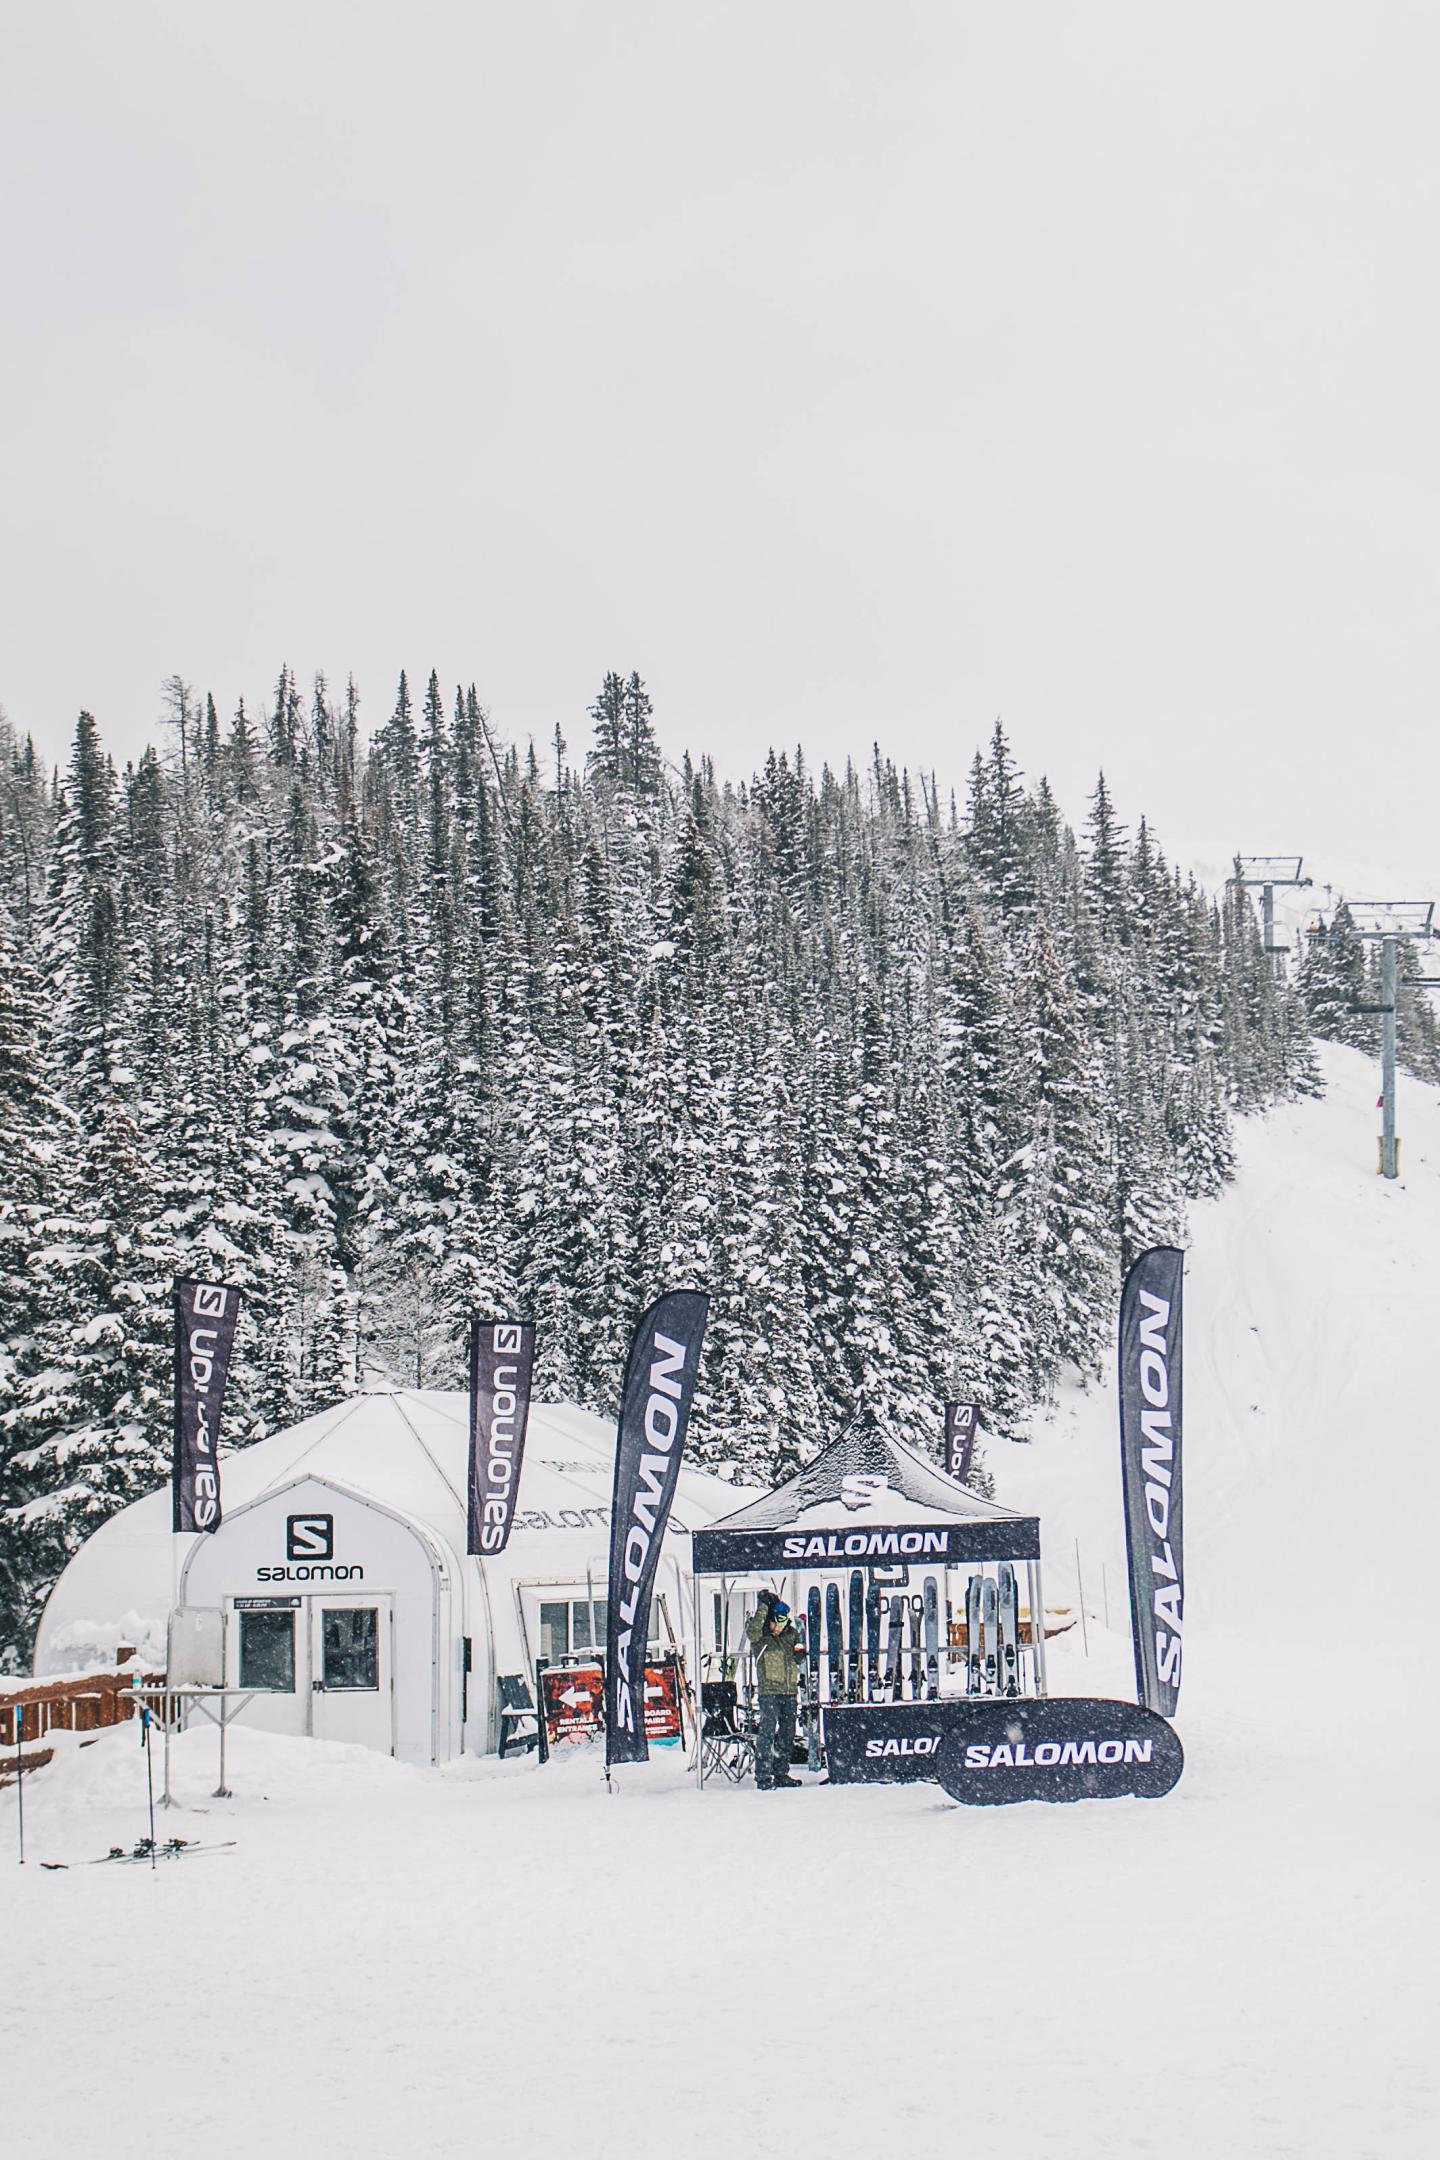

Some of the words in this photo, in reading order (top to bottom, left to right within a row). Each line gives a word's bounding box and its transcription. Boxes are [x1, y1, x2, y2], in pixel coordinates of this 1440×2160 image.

[480, 1365, 518, 1549] salomon
[1139, 1289, 1184, 1688] SALOMON
[782, 1531, 949, 1559] SALOMON
[256, 1565, 364, 1582] salomon
[964, 1739, 1153, 1769] SALOMON
